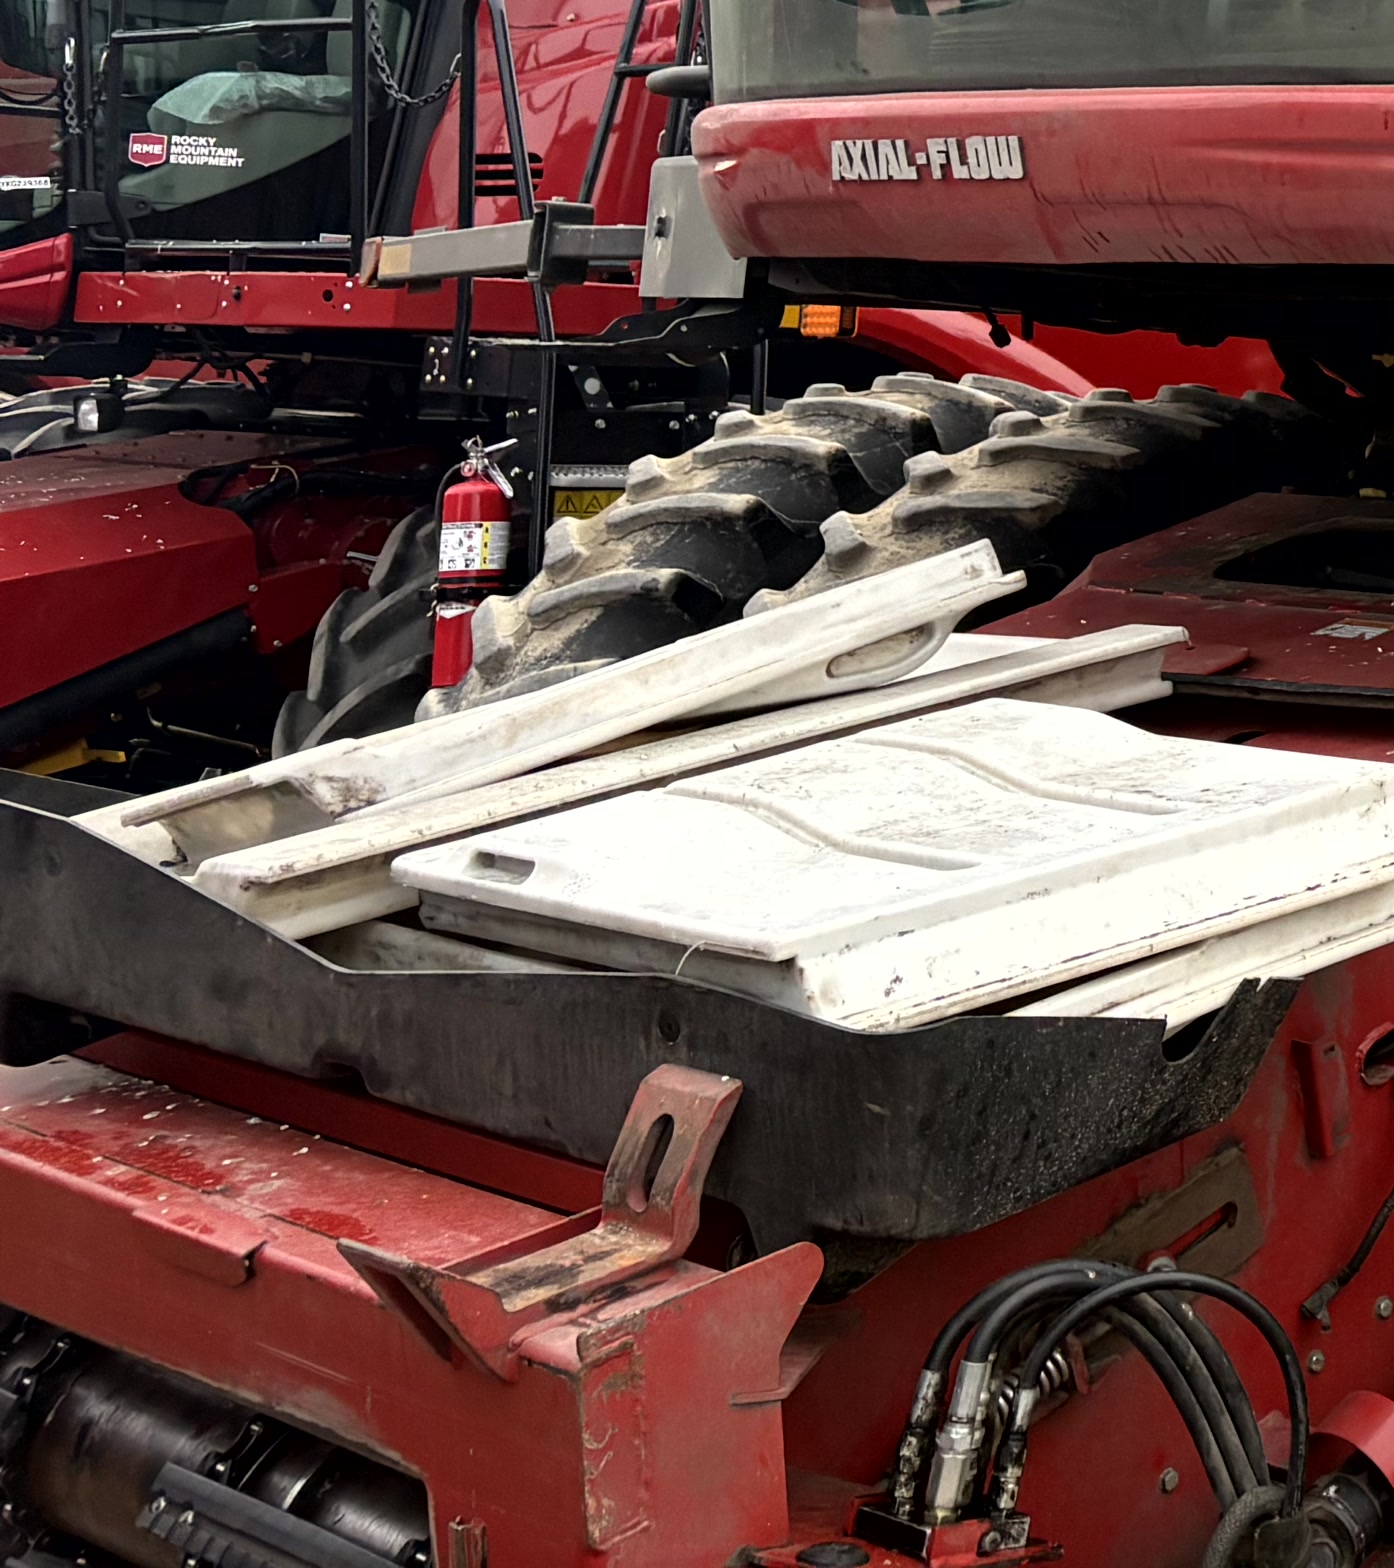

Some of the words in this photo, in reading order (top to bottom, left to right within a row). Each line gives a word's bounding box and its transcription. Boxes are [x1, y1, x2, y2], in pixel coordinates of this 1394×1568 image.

[171, 135, 217, 146] ROCKY
[132, 143, 163, 155] RME
[170, 145, 238, 158] MOUNTAIN
[169, 154, 245, 167] EQUIPMENT
[831, 135, 1024, 181] AXIAL-FLOW
